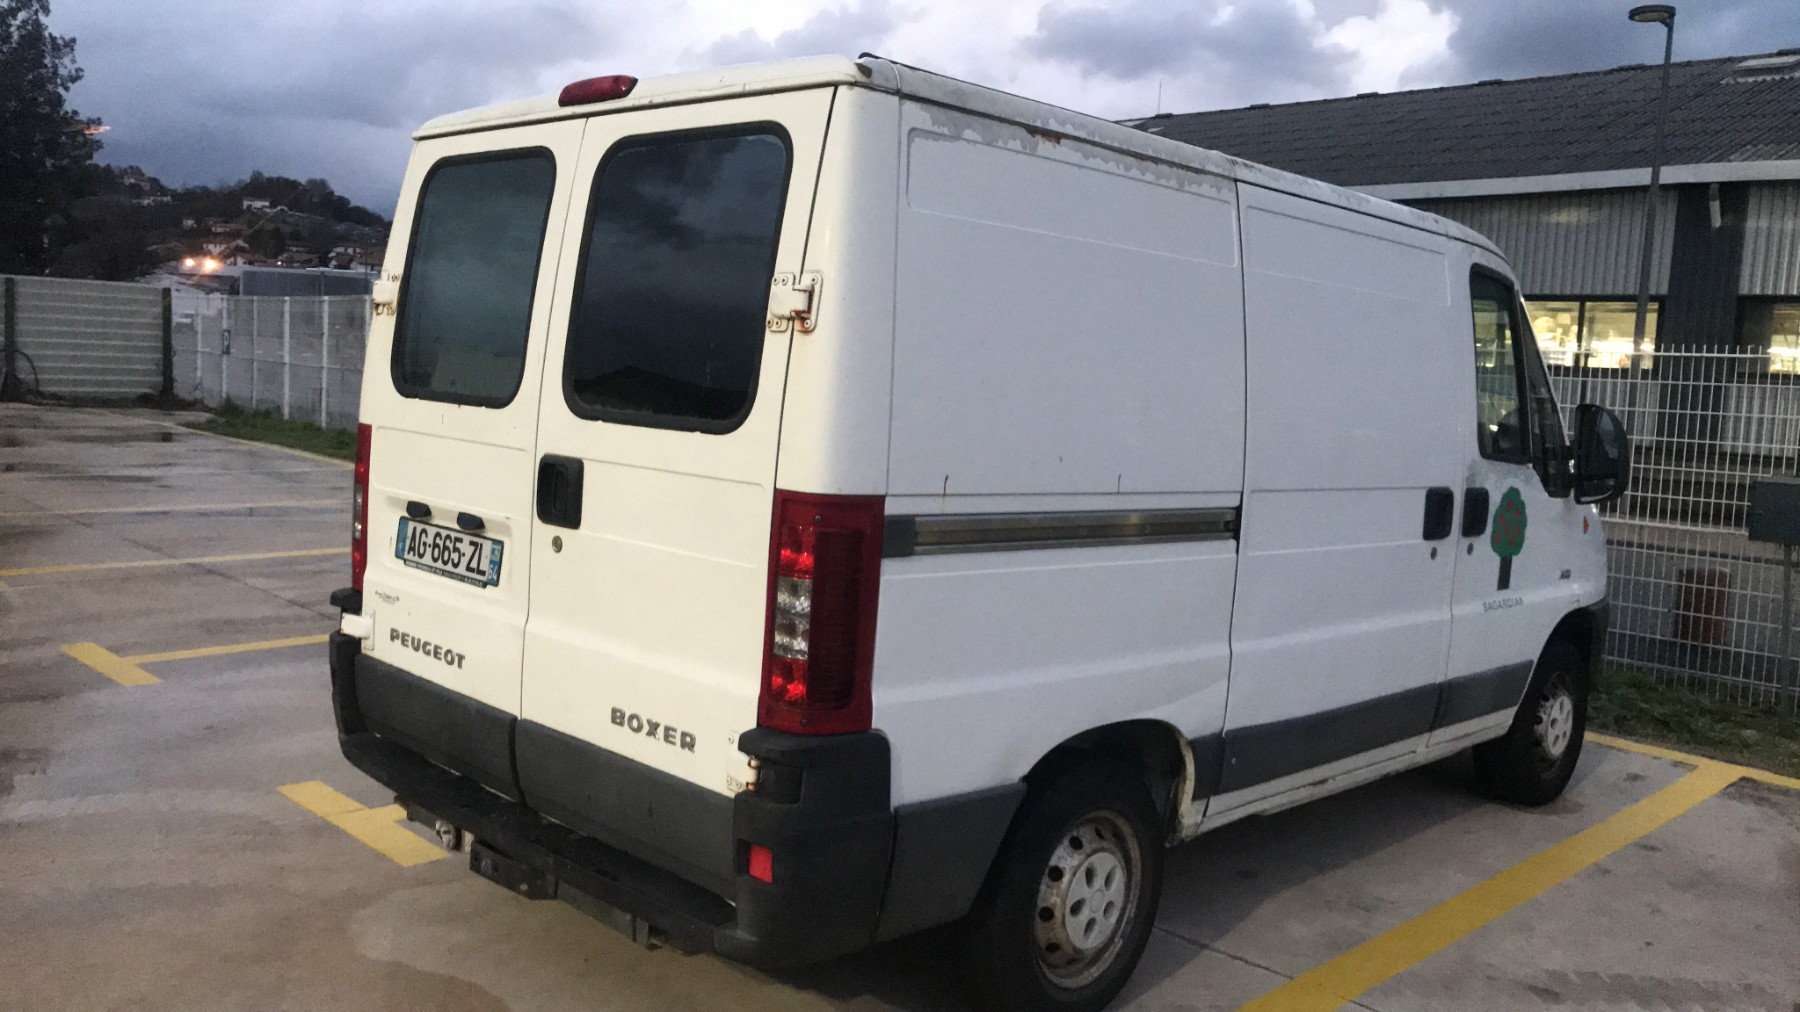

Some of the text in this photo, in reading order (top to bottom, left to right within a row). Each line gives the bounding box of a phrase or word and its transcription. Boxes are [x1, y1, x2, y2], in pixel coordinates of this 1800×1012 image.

[407, 526, 487, 576] AG-665-ZL
[390, 627, 466, 670] PEUGEOT
[611, 706, 696, 754] BOXER
